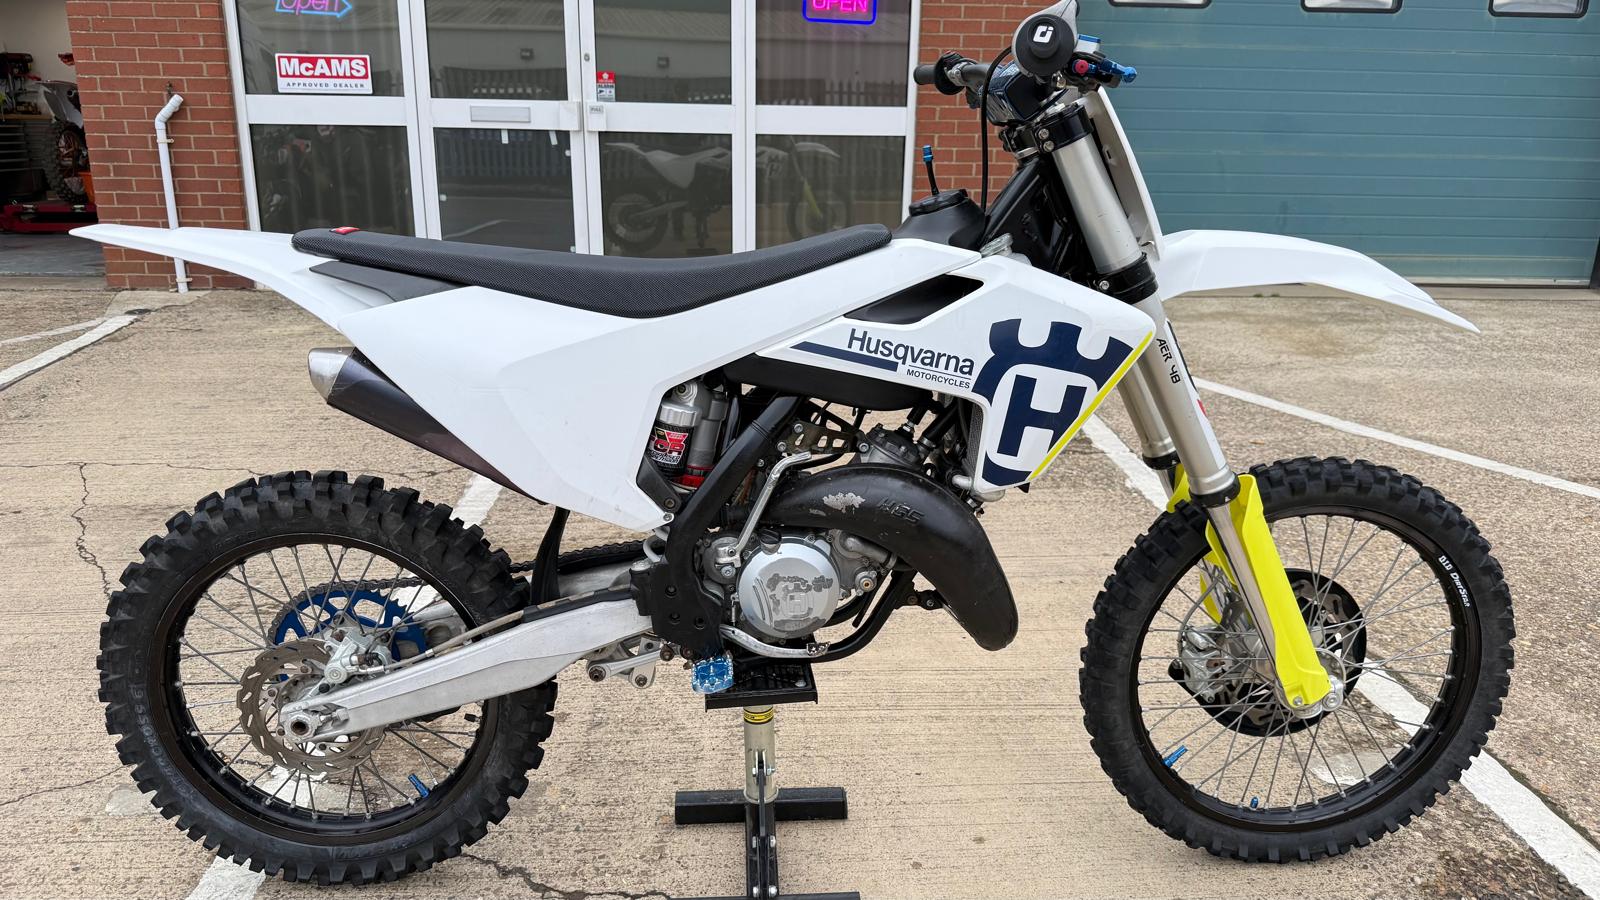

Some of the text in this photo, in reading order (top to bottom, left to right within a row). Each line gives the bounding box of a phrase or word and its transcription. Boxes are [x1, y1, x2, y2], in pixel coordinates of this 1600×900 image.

[812, 0, 868, 12] OPEN
[279, 57, 367, 77] McAMS
[847, 327, 975, 376] Husqvarna
[1156, 338, 1173, 362] AER
[906, 368, 971, 389] MOTORCYCLES
